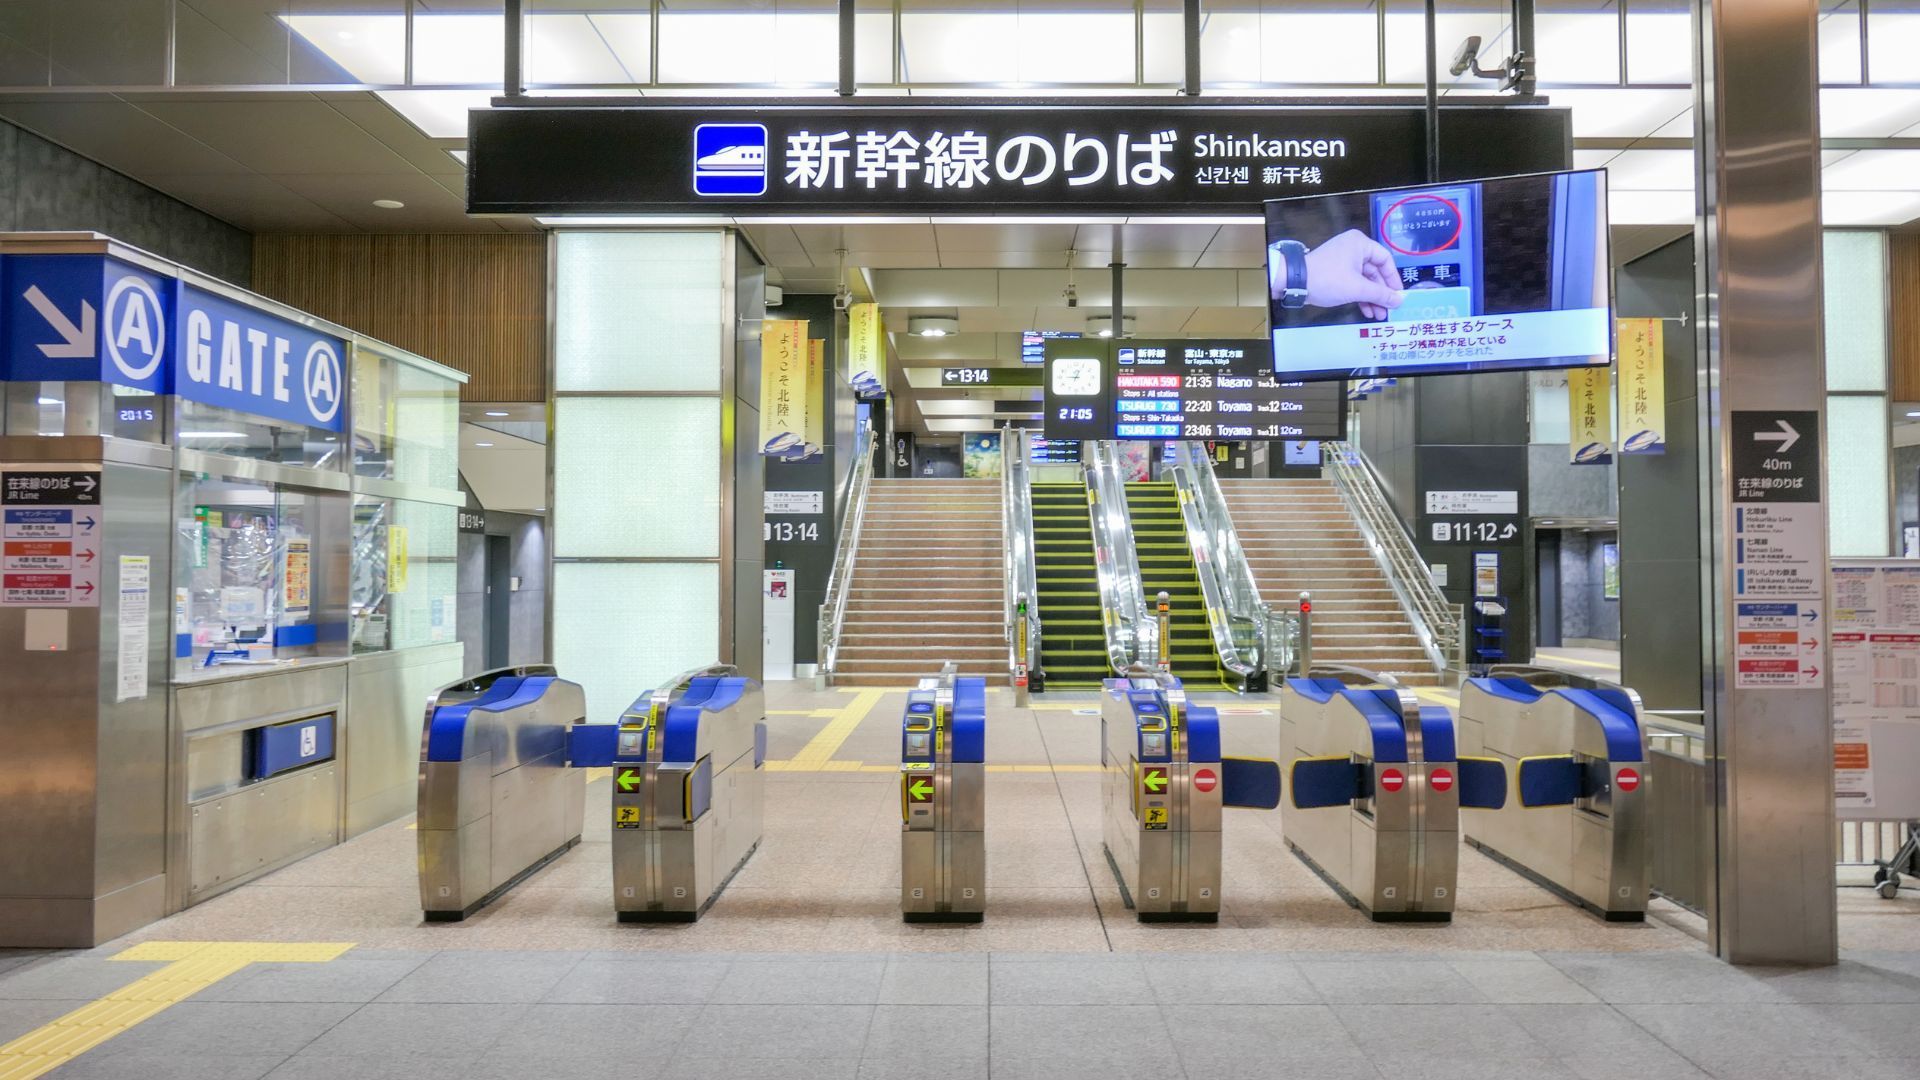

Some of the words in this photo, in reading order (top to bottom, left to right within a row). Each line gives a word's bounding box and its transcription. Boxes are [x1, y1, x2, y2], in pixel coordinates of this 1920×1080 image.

[1194, 134, 1346, 158] Shinkansen
[784, 130, 1178, 189] 新幹線のりば
[1195, 167, 1249, 184] 신칸센
[1262, 167, 1322, 184] 新干线
[1371, 318, 1514, 338] エラーが発生するケース
[186, 309, 290, 403] GATE
[777, 332, 791, 428] ようこそ北陸へ
[1160, 377, 1177, 387] 590
[1185, 376, 1212, 388] 21:35
[1217, 377, 1252, 388] Nagano
[1634, 331, 1648, 426] ようこそ北陸へ
[1123, 390, 1140, 398] Stops
[1120, 401, 1156, 411] TSURUGI
[1185, 400, 1212, 412] 22:20
[1217, 400, 1252, 412] Toyama
[1269, 401, 1280, 412] 12
[1059, 408, 1093, 420] 21:05
[1123, 414, 1140, 422] Stops
[1120, 425, 1156, 436] TSURUGI
[1185, 425, 1212, 436] 23:06
[1217, 425, 1252, 437] Toyama
[1268, 425, 1279, 436] 11
[1762, 458, 1792, 471] 40m
[8, 477, 71, 490] 在来線のりば
[1738, 477, 1804, 489] 在来線のりば
[20, 491, 40, 500] Line
[1749, 489, 1765, 498] Line
